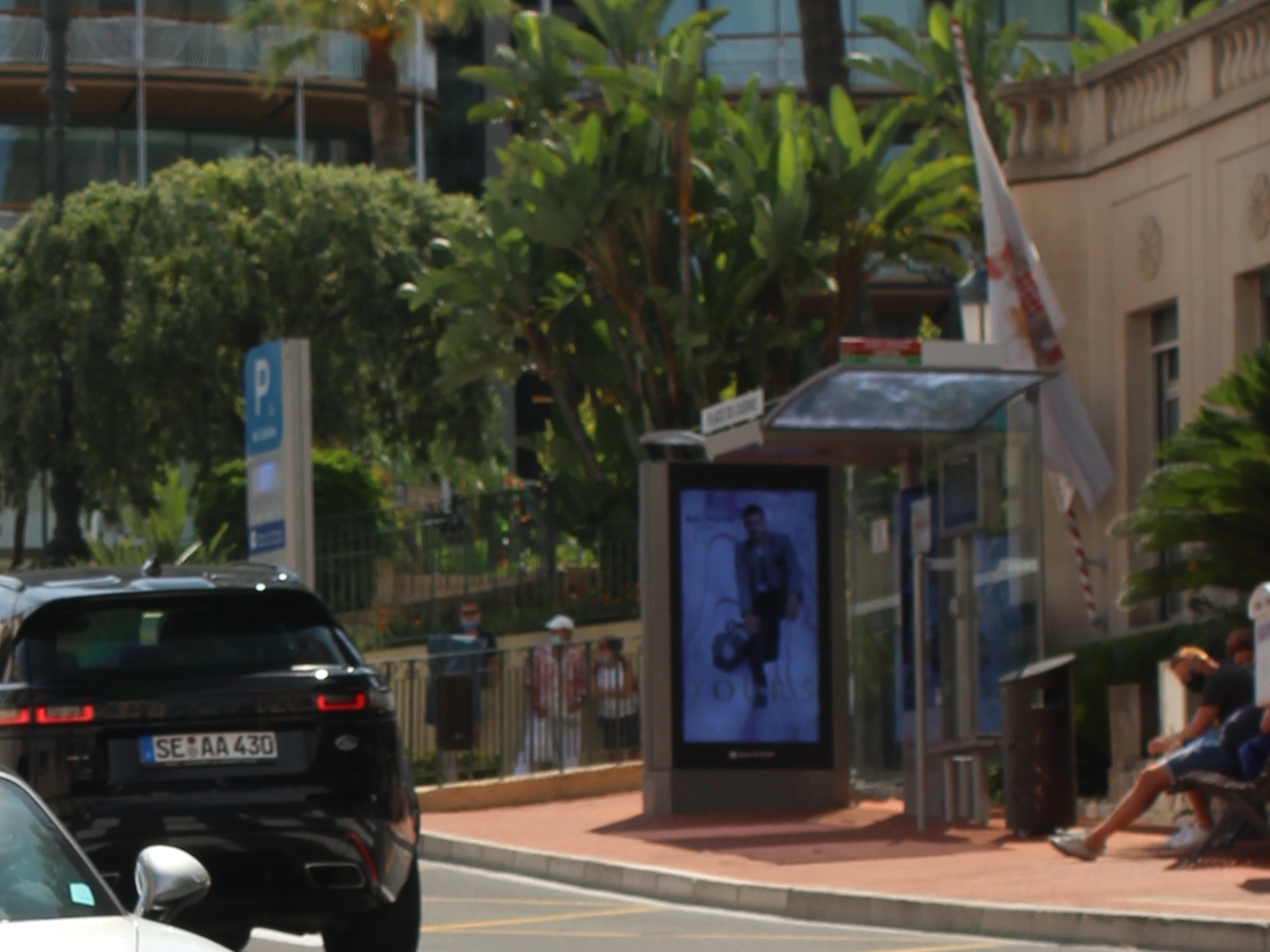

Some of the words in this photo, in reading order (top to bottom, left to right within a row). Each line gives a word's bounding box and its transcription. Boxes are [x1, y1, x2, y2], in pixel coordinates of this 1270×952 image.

[254, 358, 271, 417] P
[156, 738, 185, 758] SE
[202, 736, 229, 756] AA
[234, 735, 274, 755] 430
